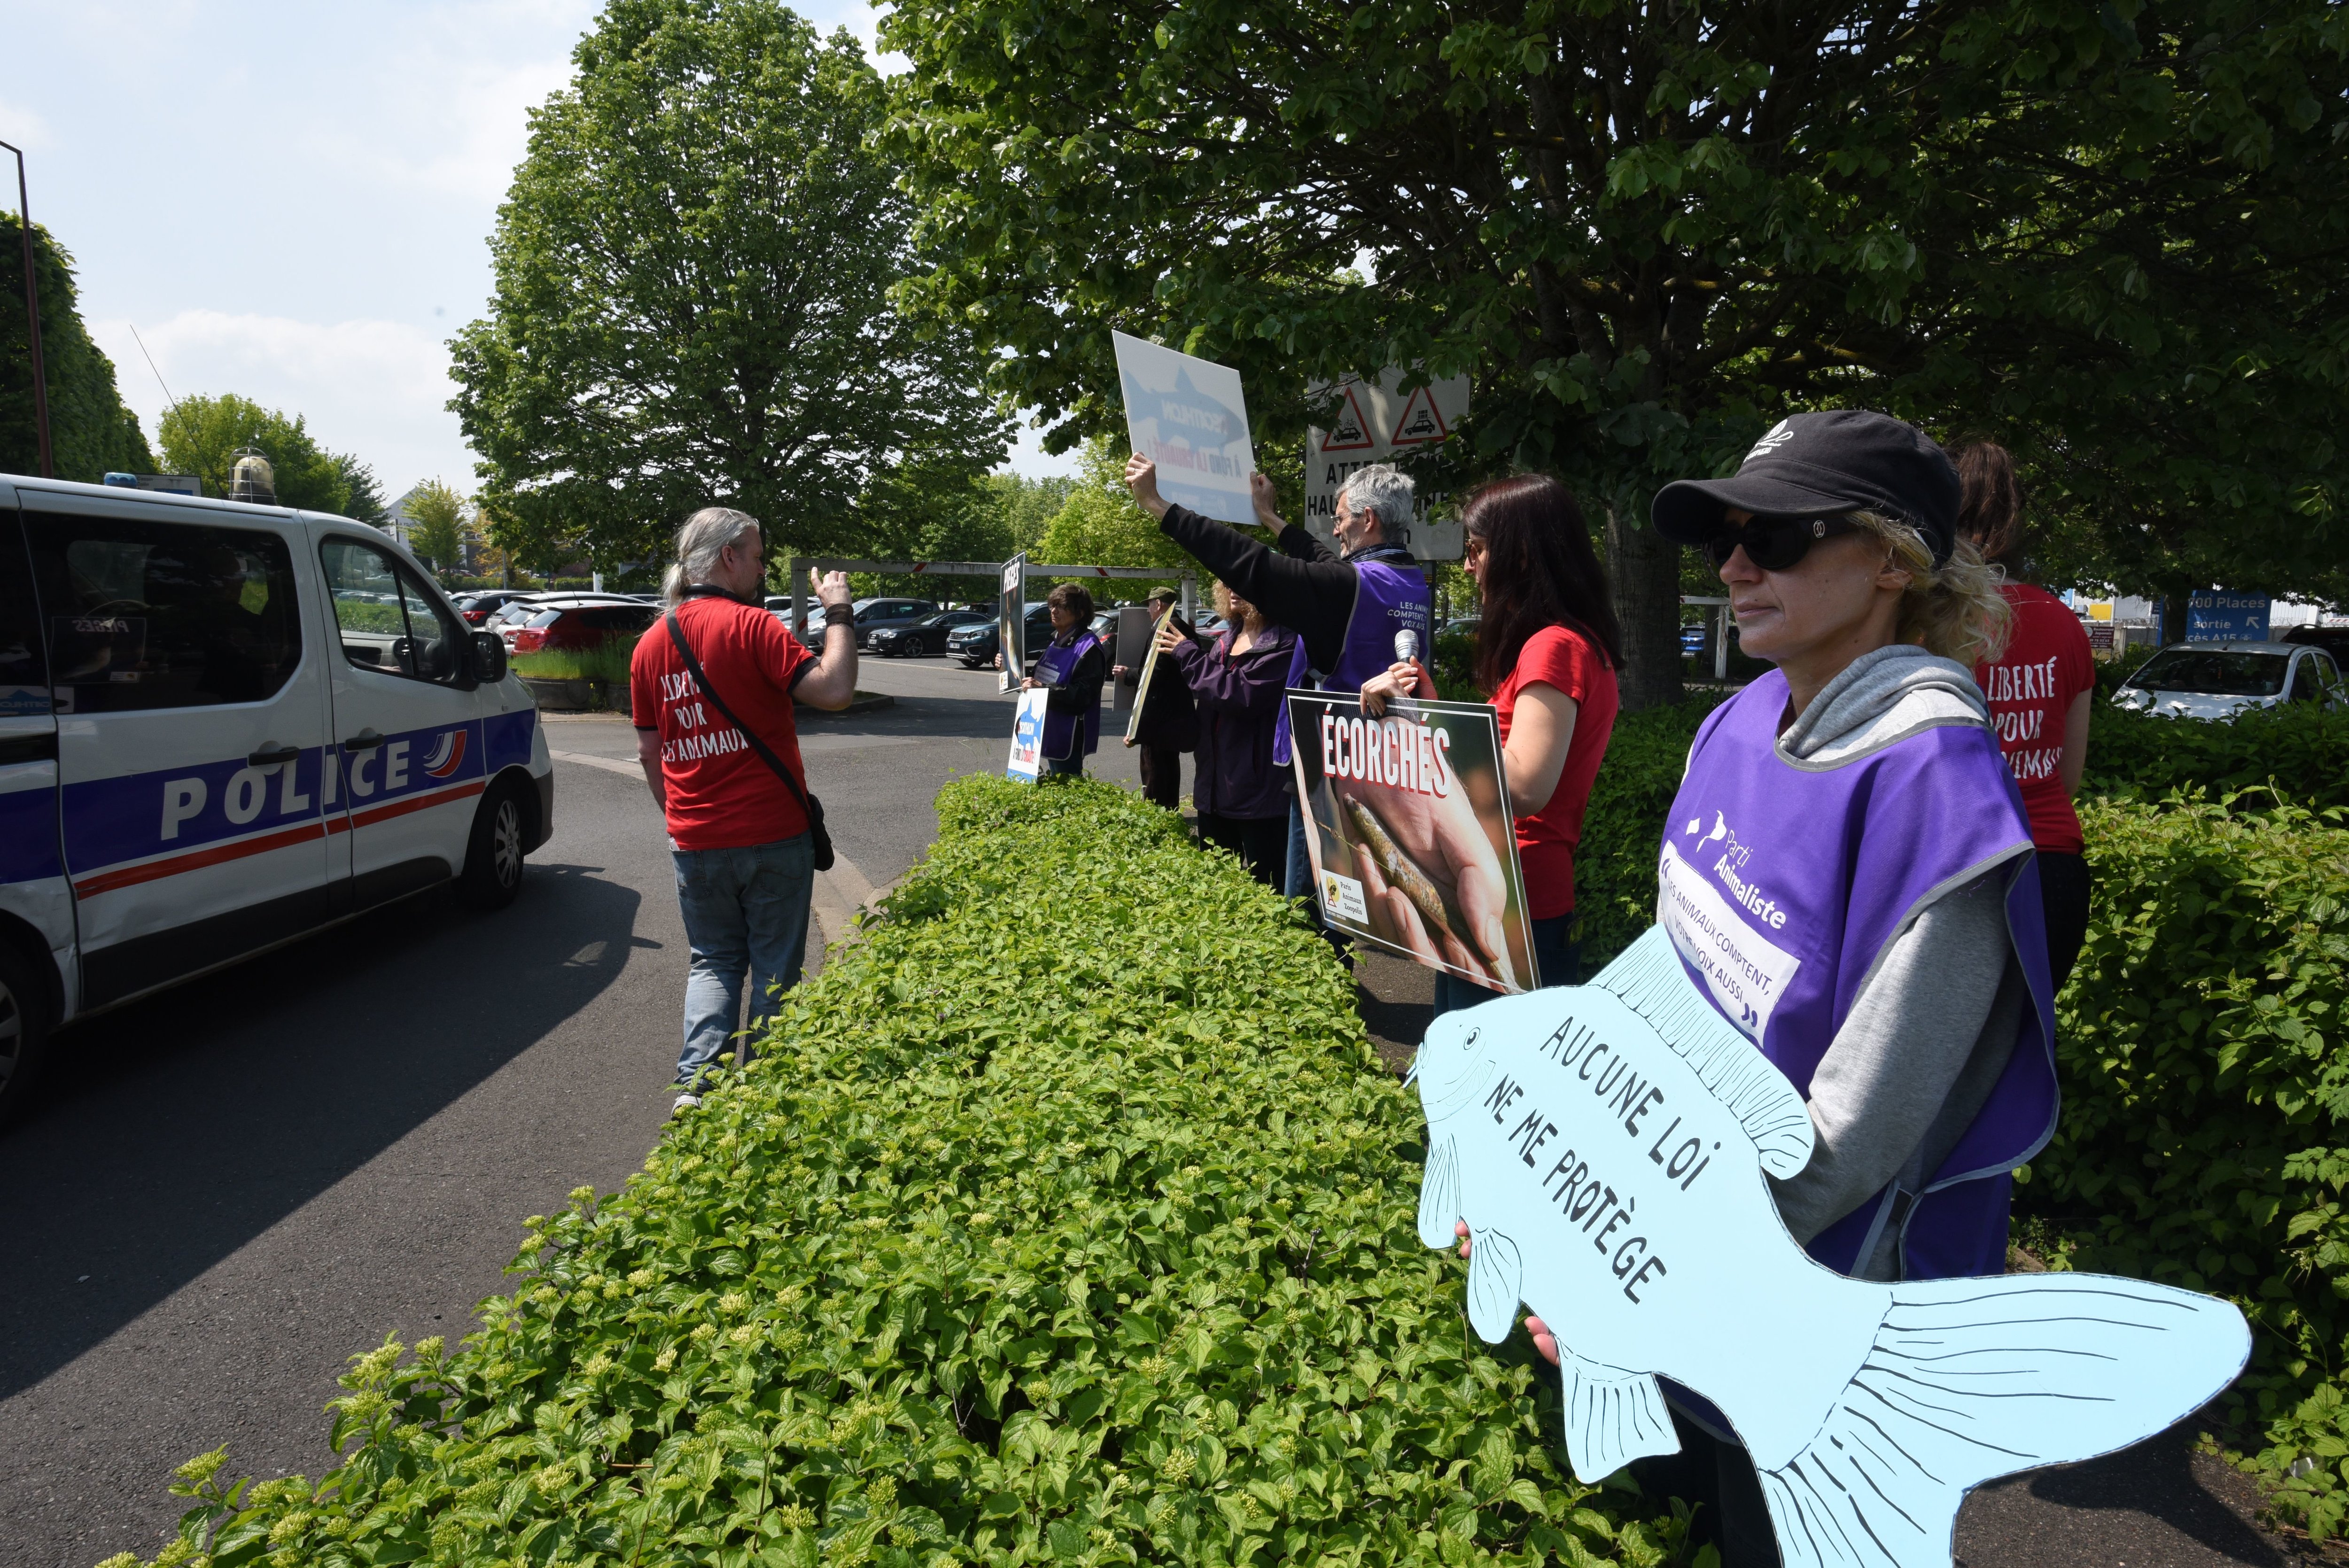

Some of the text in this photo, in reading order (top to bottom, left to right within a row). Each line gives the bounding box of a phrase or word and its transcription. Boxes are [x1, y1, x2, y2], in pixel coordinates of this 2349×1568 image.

[1400, 601, 1413, 610] LES
[2217, 597, 2265, 608] Places
[1401, 620, 1416, 629] VOIX
[2185, 633, 2208, 642] cès
[2193, 619, 2231, 629] sortie
[661, 661, 704, 702] LIBER
[1987, 656, 2057, 701] LIBERTÉ
[1995, 710, 2043, 742] POUR
[1322, 703, 1451, 797] ÉCORCHÉS
[161, 740, 410, 841] POLICE
[1725, 830, 1753, 868] Parti
[1340, 881, 1352, 891] Paris
[1343, 893, 1362, 905] Animaux
[1714, 854, 1786, 929] Animaliste
[1344, 903, 1362, 915] Zoopolis
[1676, 891, 1716, 940] ANIMAUX
[1716, 932, 1772, 995] COMPTENT,
[1694, 943, 1715, 974] VOIX
[1715, 968, 1743, 1003] AUSSI
[1540, 1016, 1664, 1138] AUCUNE
[1484, 1073, 1667, 1305] NE ME PROTÈGE
